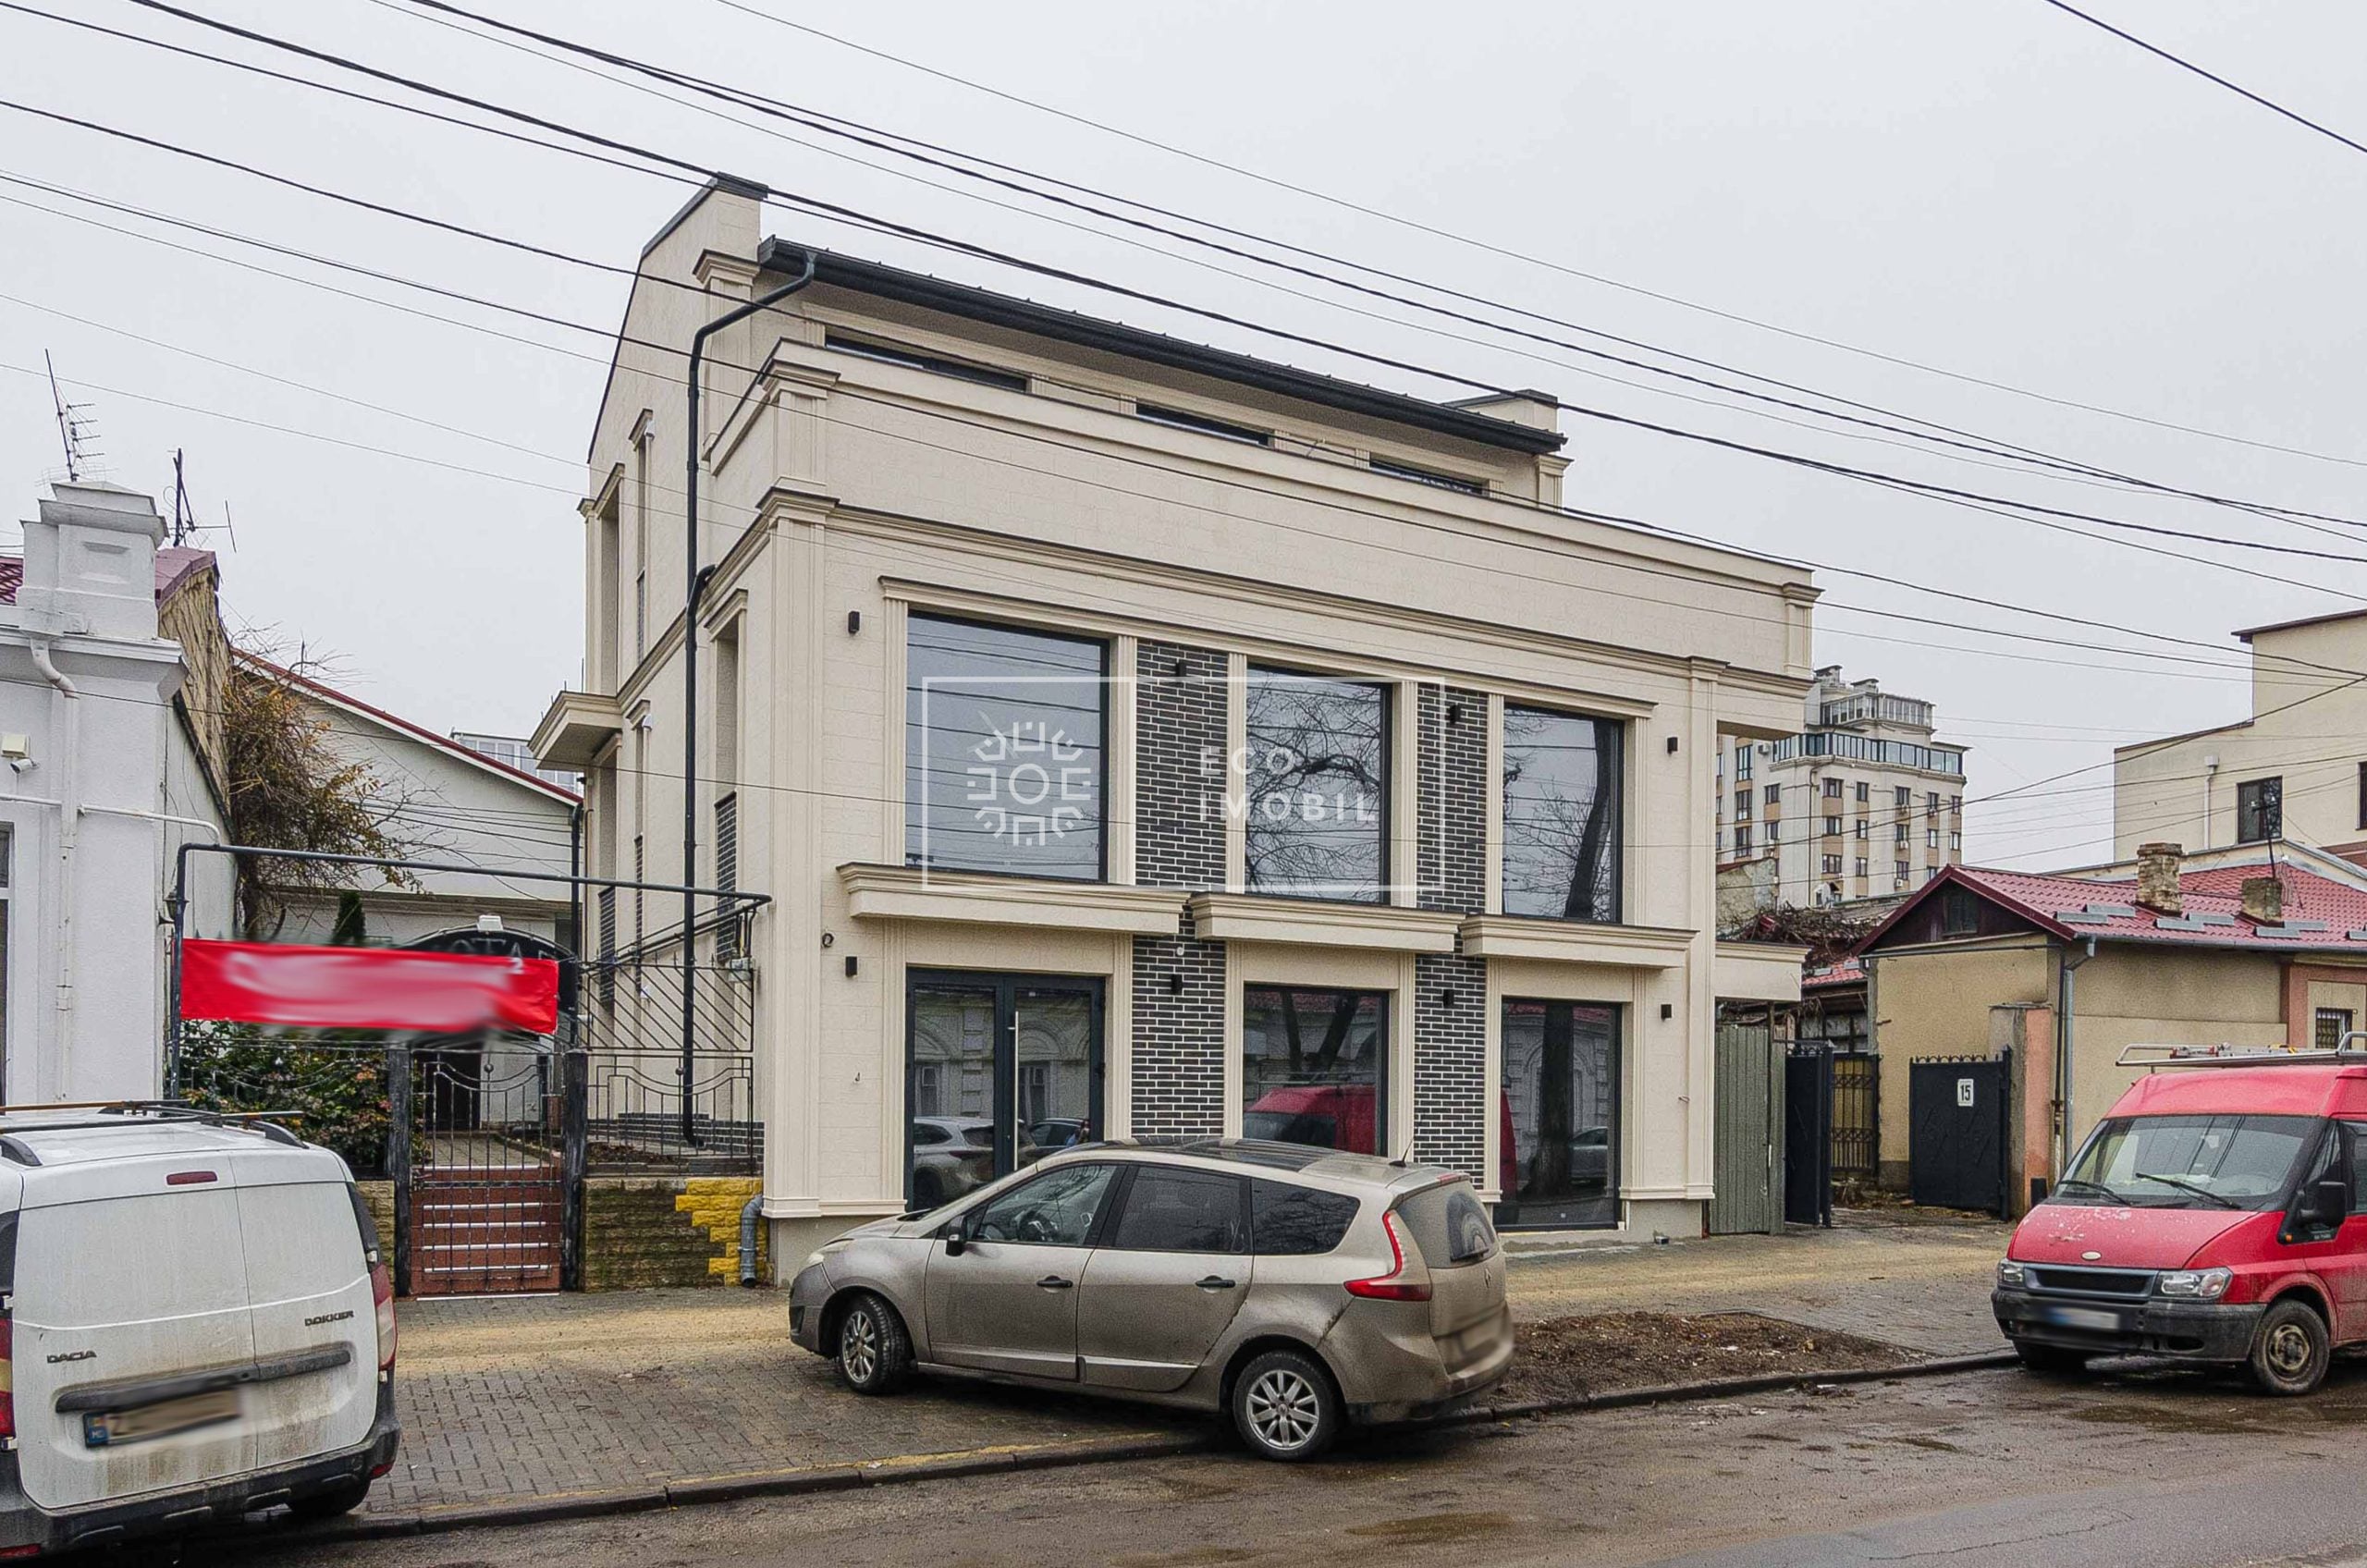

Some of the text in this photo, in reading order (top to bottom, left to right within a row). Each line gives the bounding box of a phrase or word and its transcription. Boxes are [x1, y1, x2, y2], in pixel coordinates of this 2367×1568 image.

[1960, 1084, 1970, 1101] 15
[304, 1310, 354, 1327] DOKKER
[47, 1350, 97, 1364] DACIA
